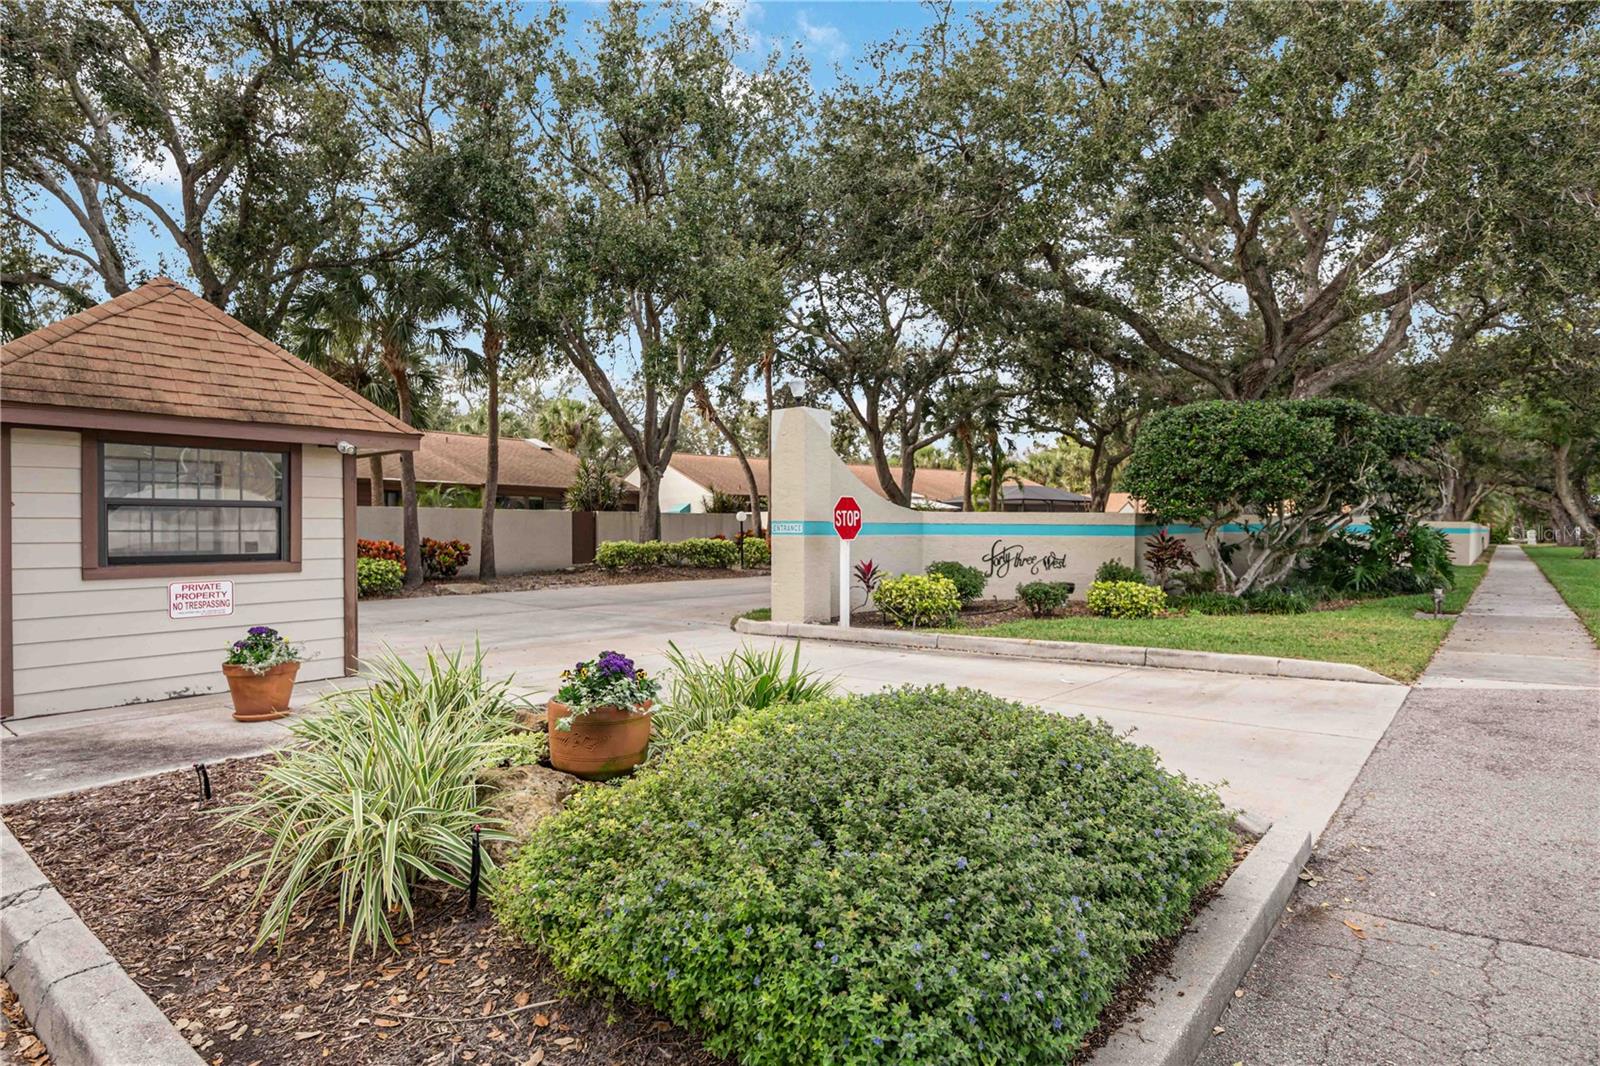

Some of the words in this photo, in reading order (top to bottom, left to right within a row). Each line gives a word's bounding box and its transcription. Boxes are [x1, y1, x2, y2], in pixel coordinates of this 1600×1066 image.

[835, 510, 860, 527] STOP
[773, 524, 802, 532] ENTRANCE
[181, 583, 221, 591] PRIVATE
[175, 591, 227, 600] PROPERTY
[172, 602, 183, 611] NO
[185, 600, 230, 610] TRESPASSING
